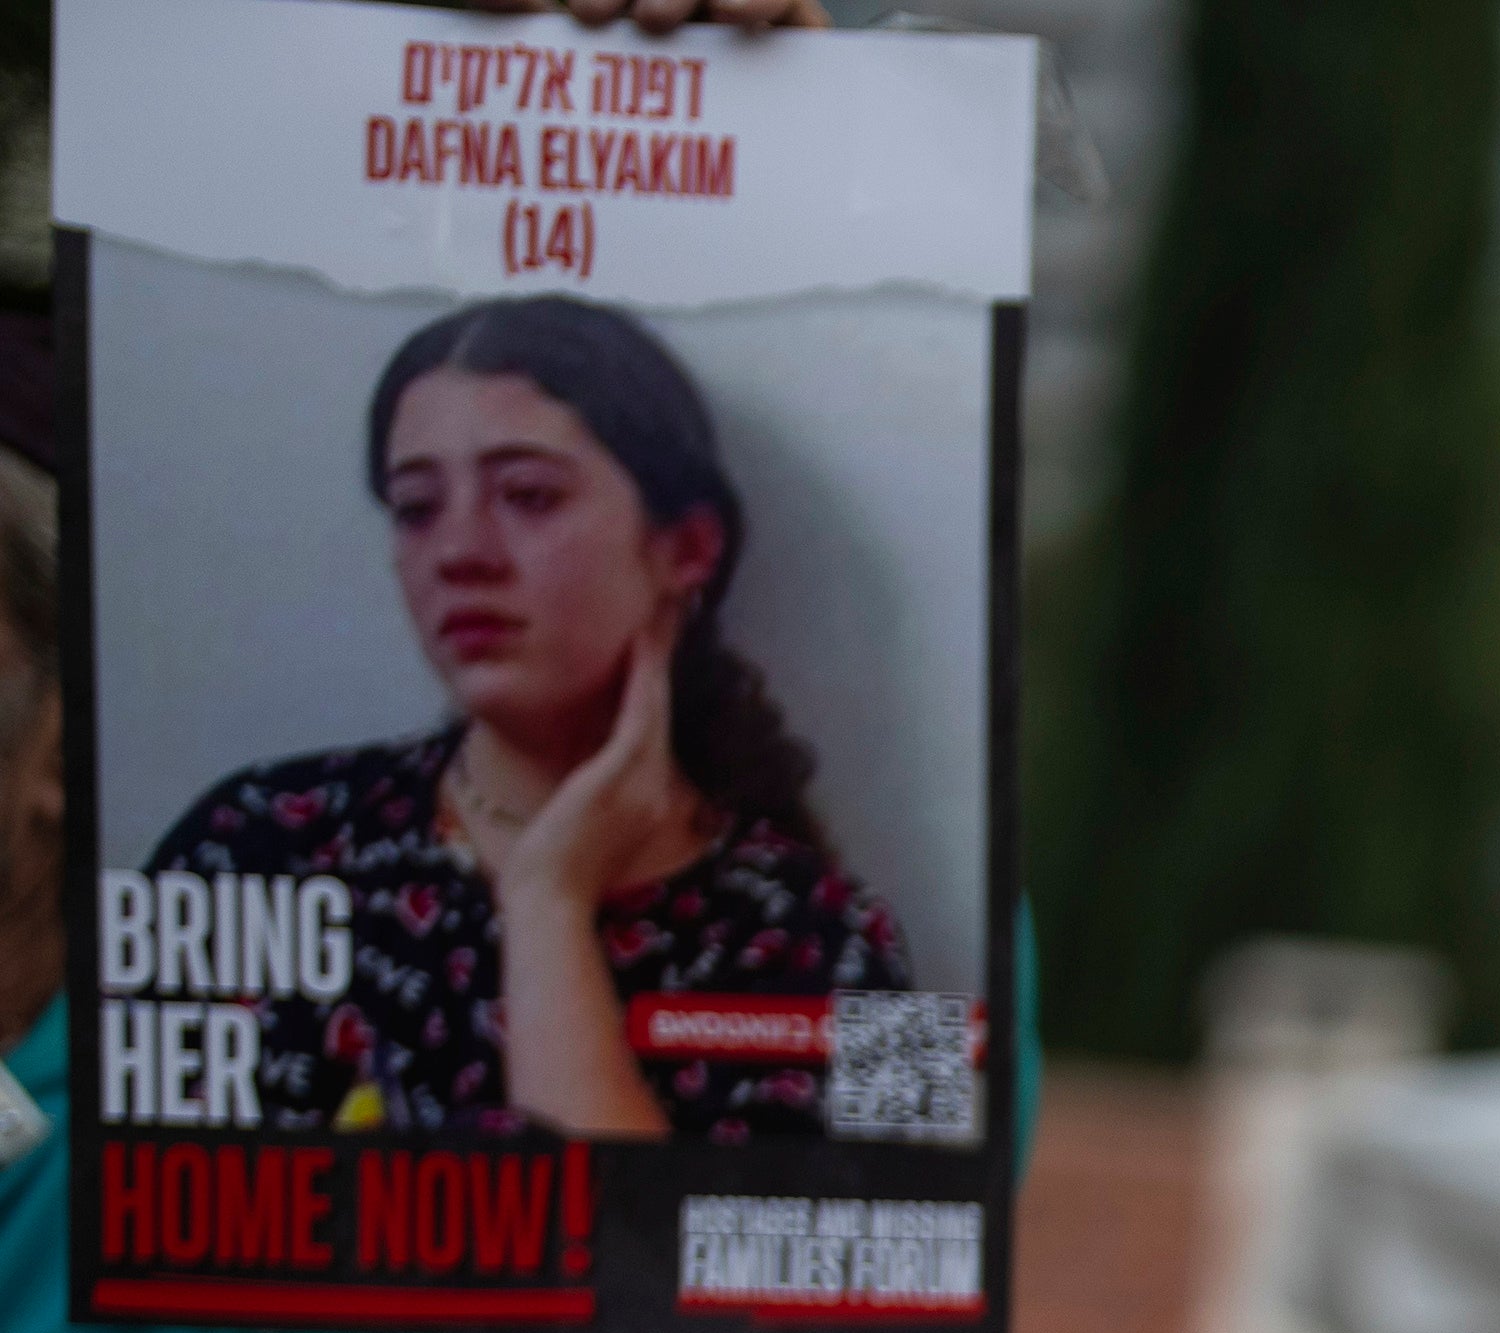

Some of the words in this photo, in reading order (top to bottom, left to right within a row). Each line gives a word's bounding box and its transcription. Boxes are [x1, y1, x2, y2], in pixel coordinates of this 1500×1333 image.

[402, 42, 574, 114] אליקים
[590, 55, 706, 122] דפנה
[366, 116, 522, 186] DAFNA
[540, 124, 736, 199] ELYAKIM
[502, 200, 596, 280] (14)
[100, 869, 354, 998] BRING
[100, 1002, 262, 1127] HER
[103, 1140, 334, 1267] HOME
[360, 1140, 592, 1277] NOW!
